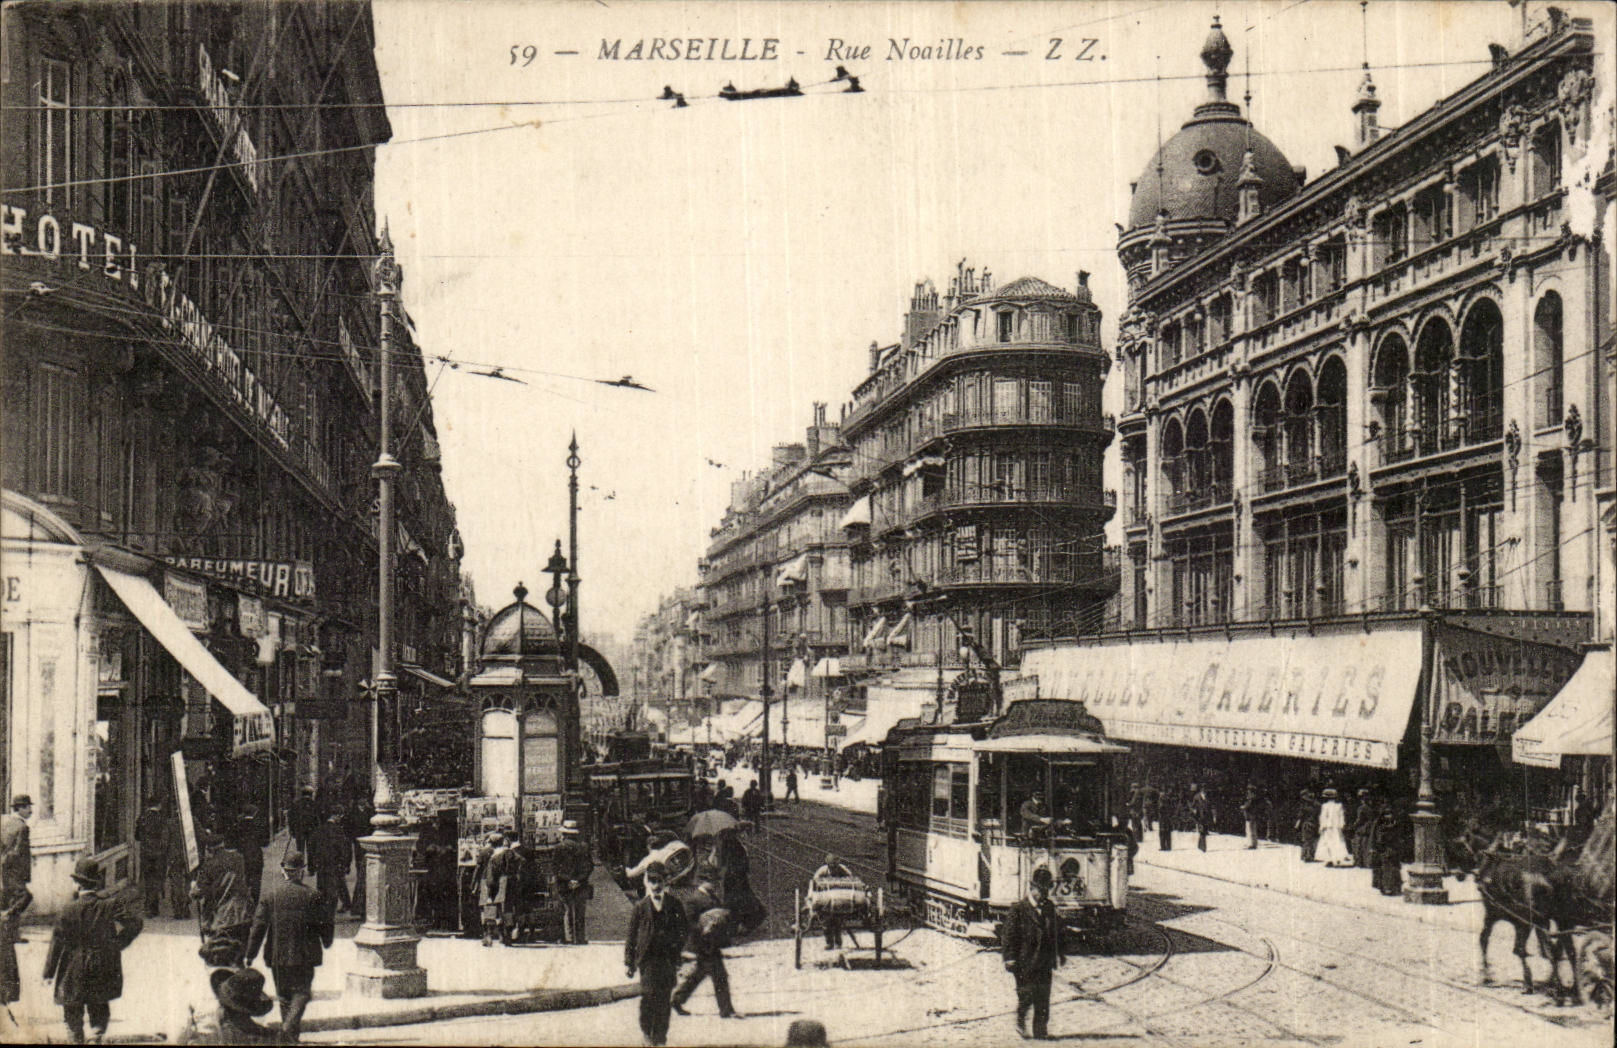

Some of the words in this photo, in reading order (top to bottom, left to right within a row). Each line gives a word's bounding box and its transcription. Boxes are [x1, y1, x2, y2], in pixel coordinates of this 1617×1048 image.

[0, 205, 138, 290] HOTEL
[164, 556, 290, 597] PARFUMEUR
[1199, 661, 1387, 720] GALERIES
[1198, 726, 1278, 750] NOUVELLES
[1288, 733, 1375, 761] GALERIES
